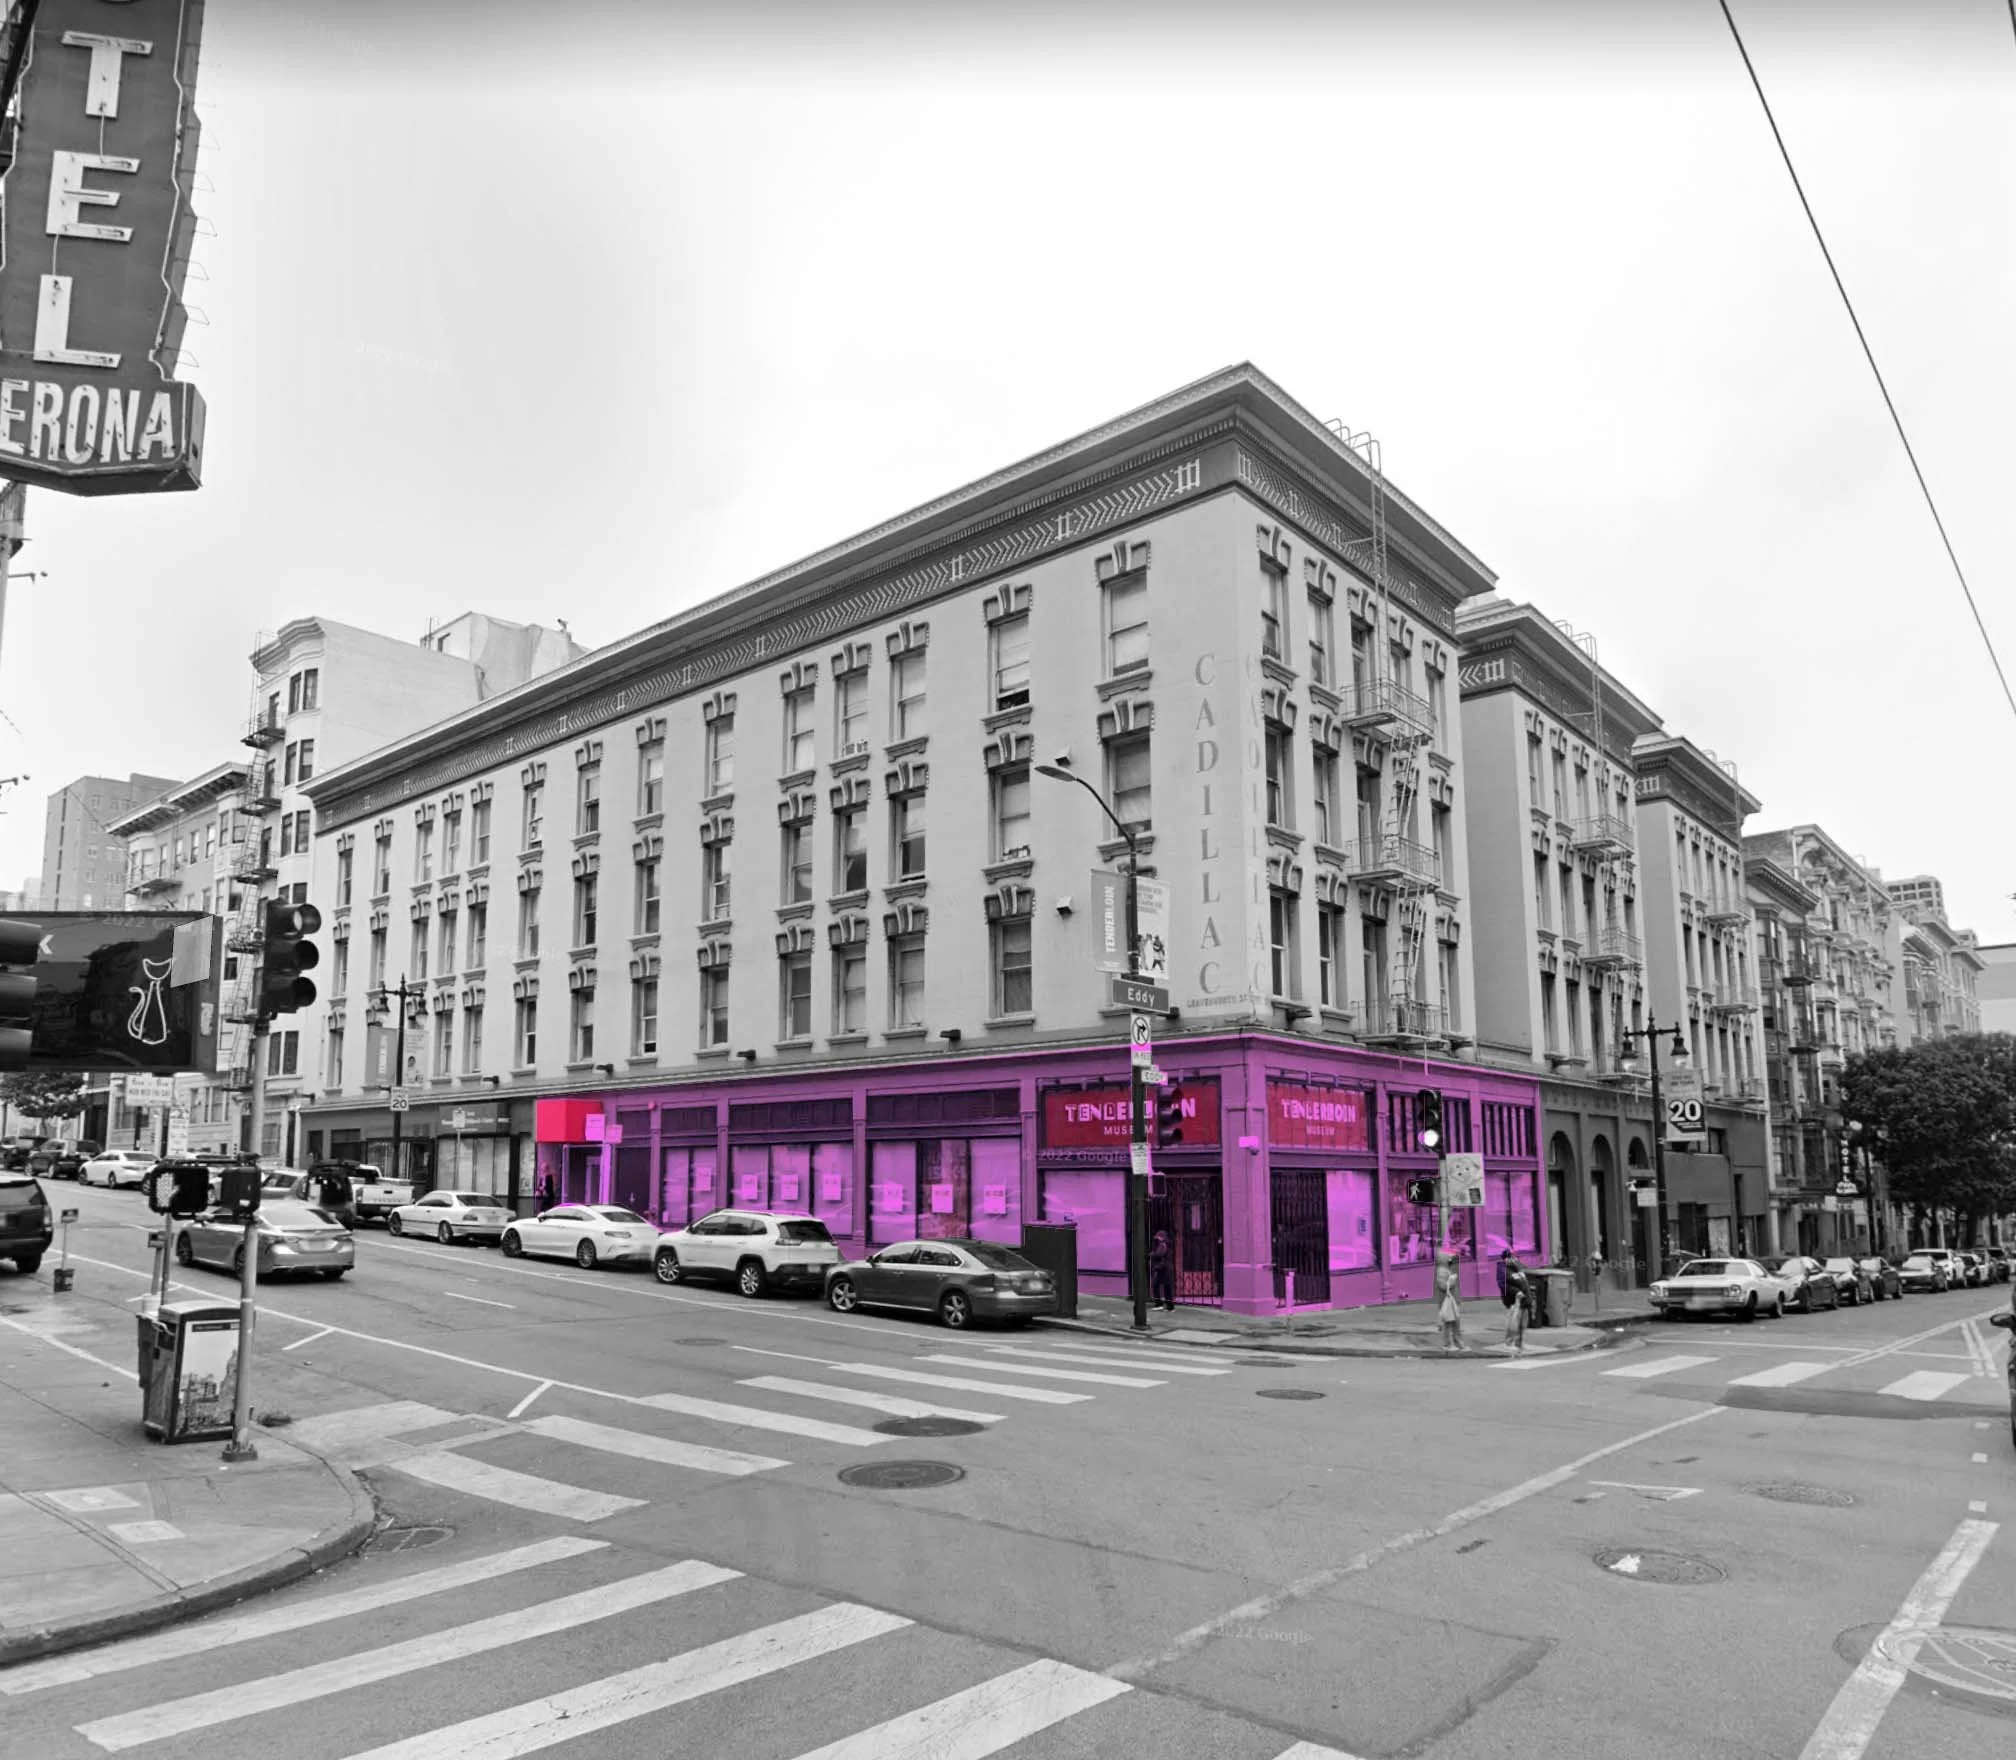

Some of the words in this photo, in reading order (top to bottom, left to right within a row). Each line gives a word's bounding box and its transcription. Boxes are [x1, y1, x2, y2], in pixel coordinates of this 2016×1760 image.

[33, 0, 154, 369] TEL
[1195, 653, 1221, 994] CADILLAC
[1104, 886, 1116, 953] TENDERLOIN
[1127, 986, 1155, 1008] Eddy
[392, 1098, 408, 1109] 20
[1669, 1099, 1702, 1122] 20
[1104, 1122, 1153, 1135] MUSEM
